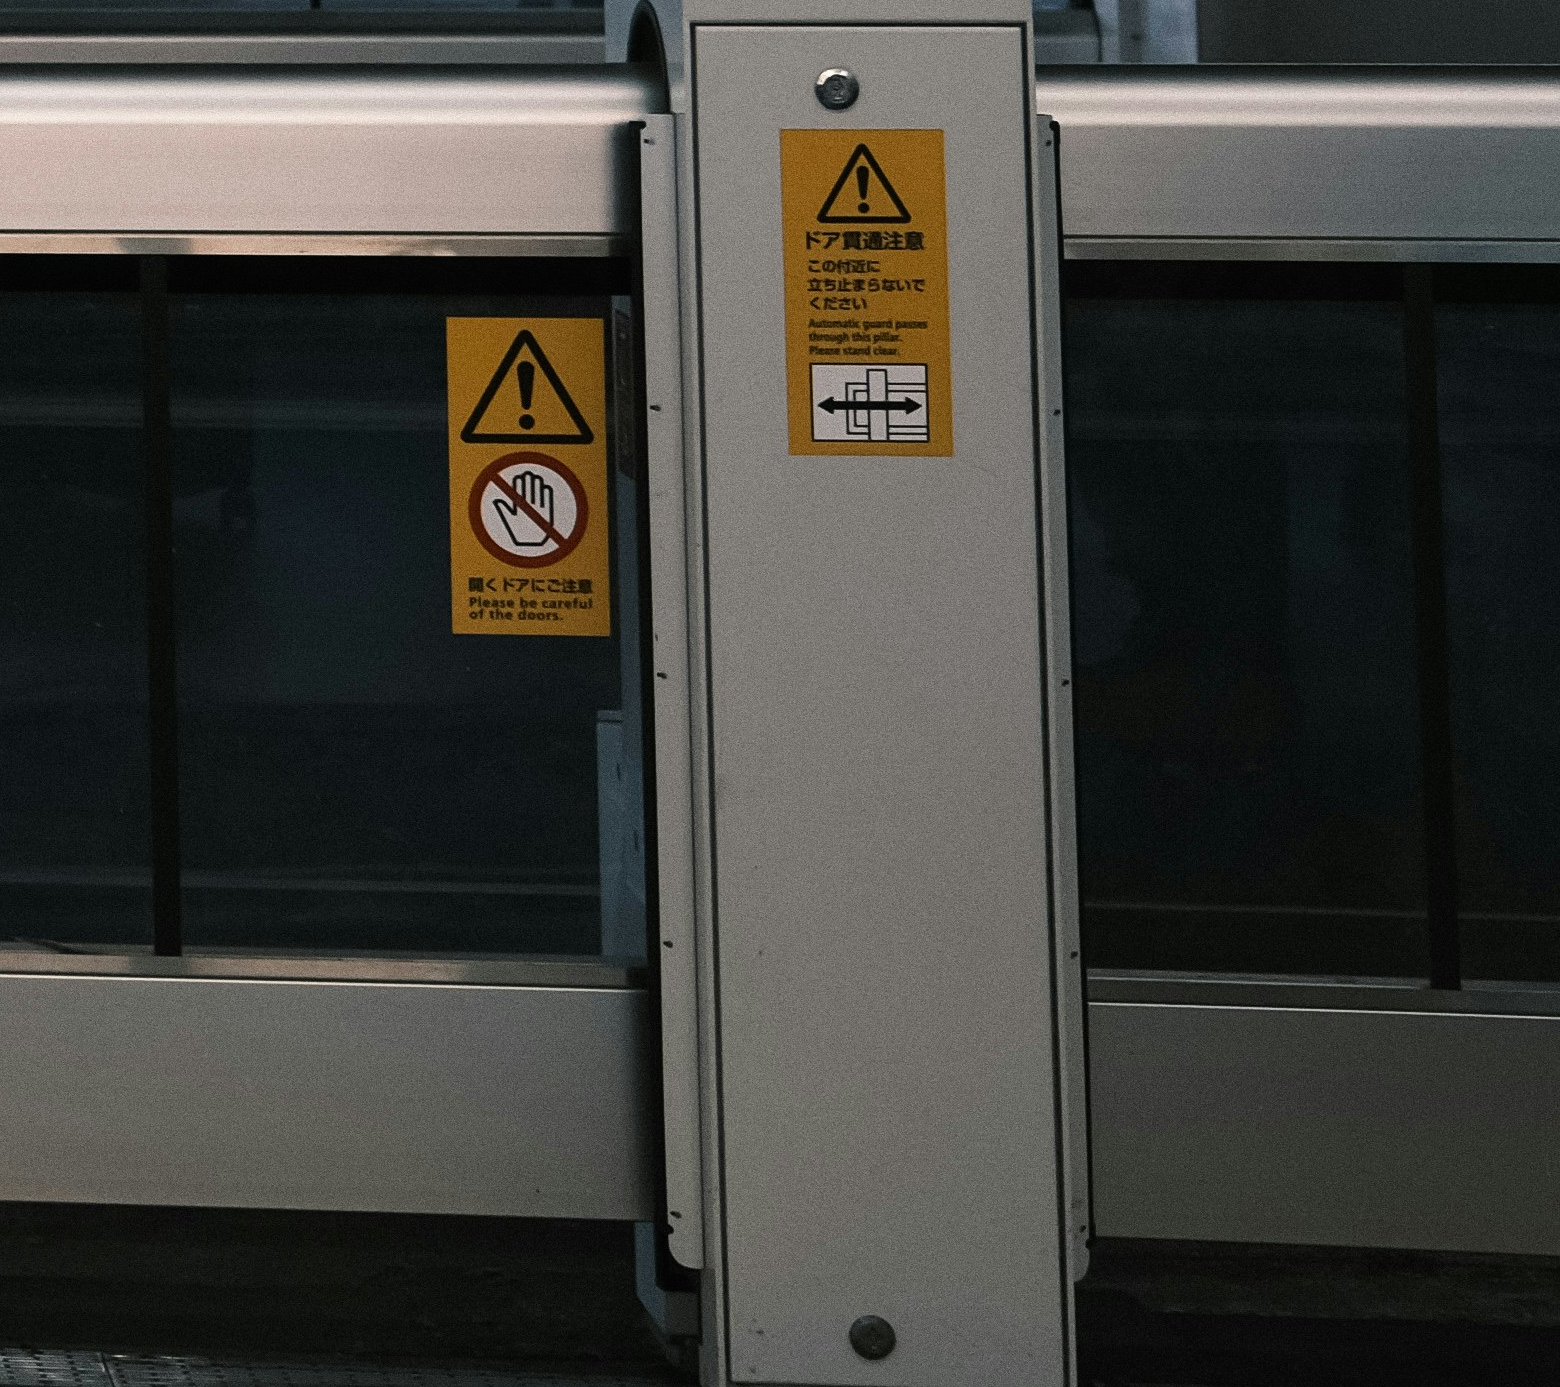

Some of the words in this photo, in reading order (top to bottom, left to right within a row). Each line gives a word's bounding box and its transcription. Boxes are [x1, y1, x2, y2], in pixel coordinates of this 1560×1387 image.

[806, 231, 924, 250] ドア貫通注意
[808, 259, 880, 273] この付近に
[807, 278, 925, 292] 立ち止まらないで
[810, 297, 868, 310] ください
[469, 597, 514, 608] Please
[520, 597, 537, 608] be
[542, 598, 592, 609] careful
[469, 609, 484, 619] of
[489, 609, 513, 619] the
[518, 610, 563, 620] doors.
